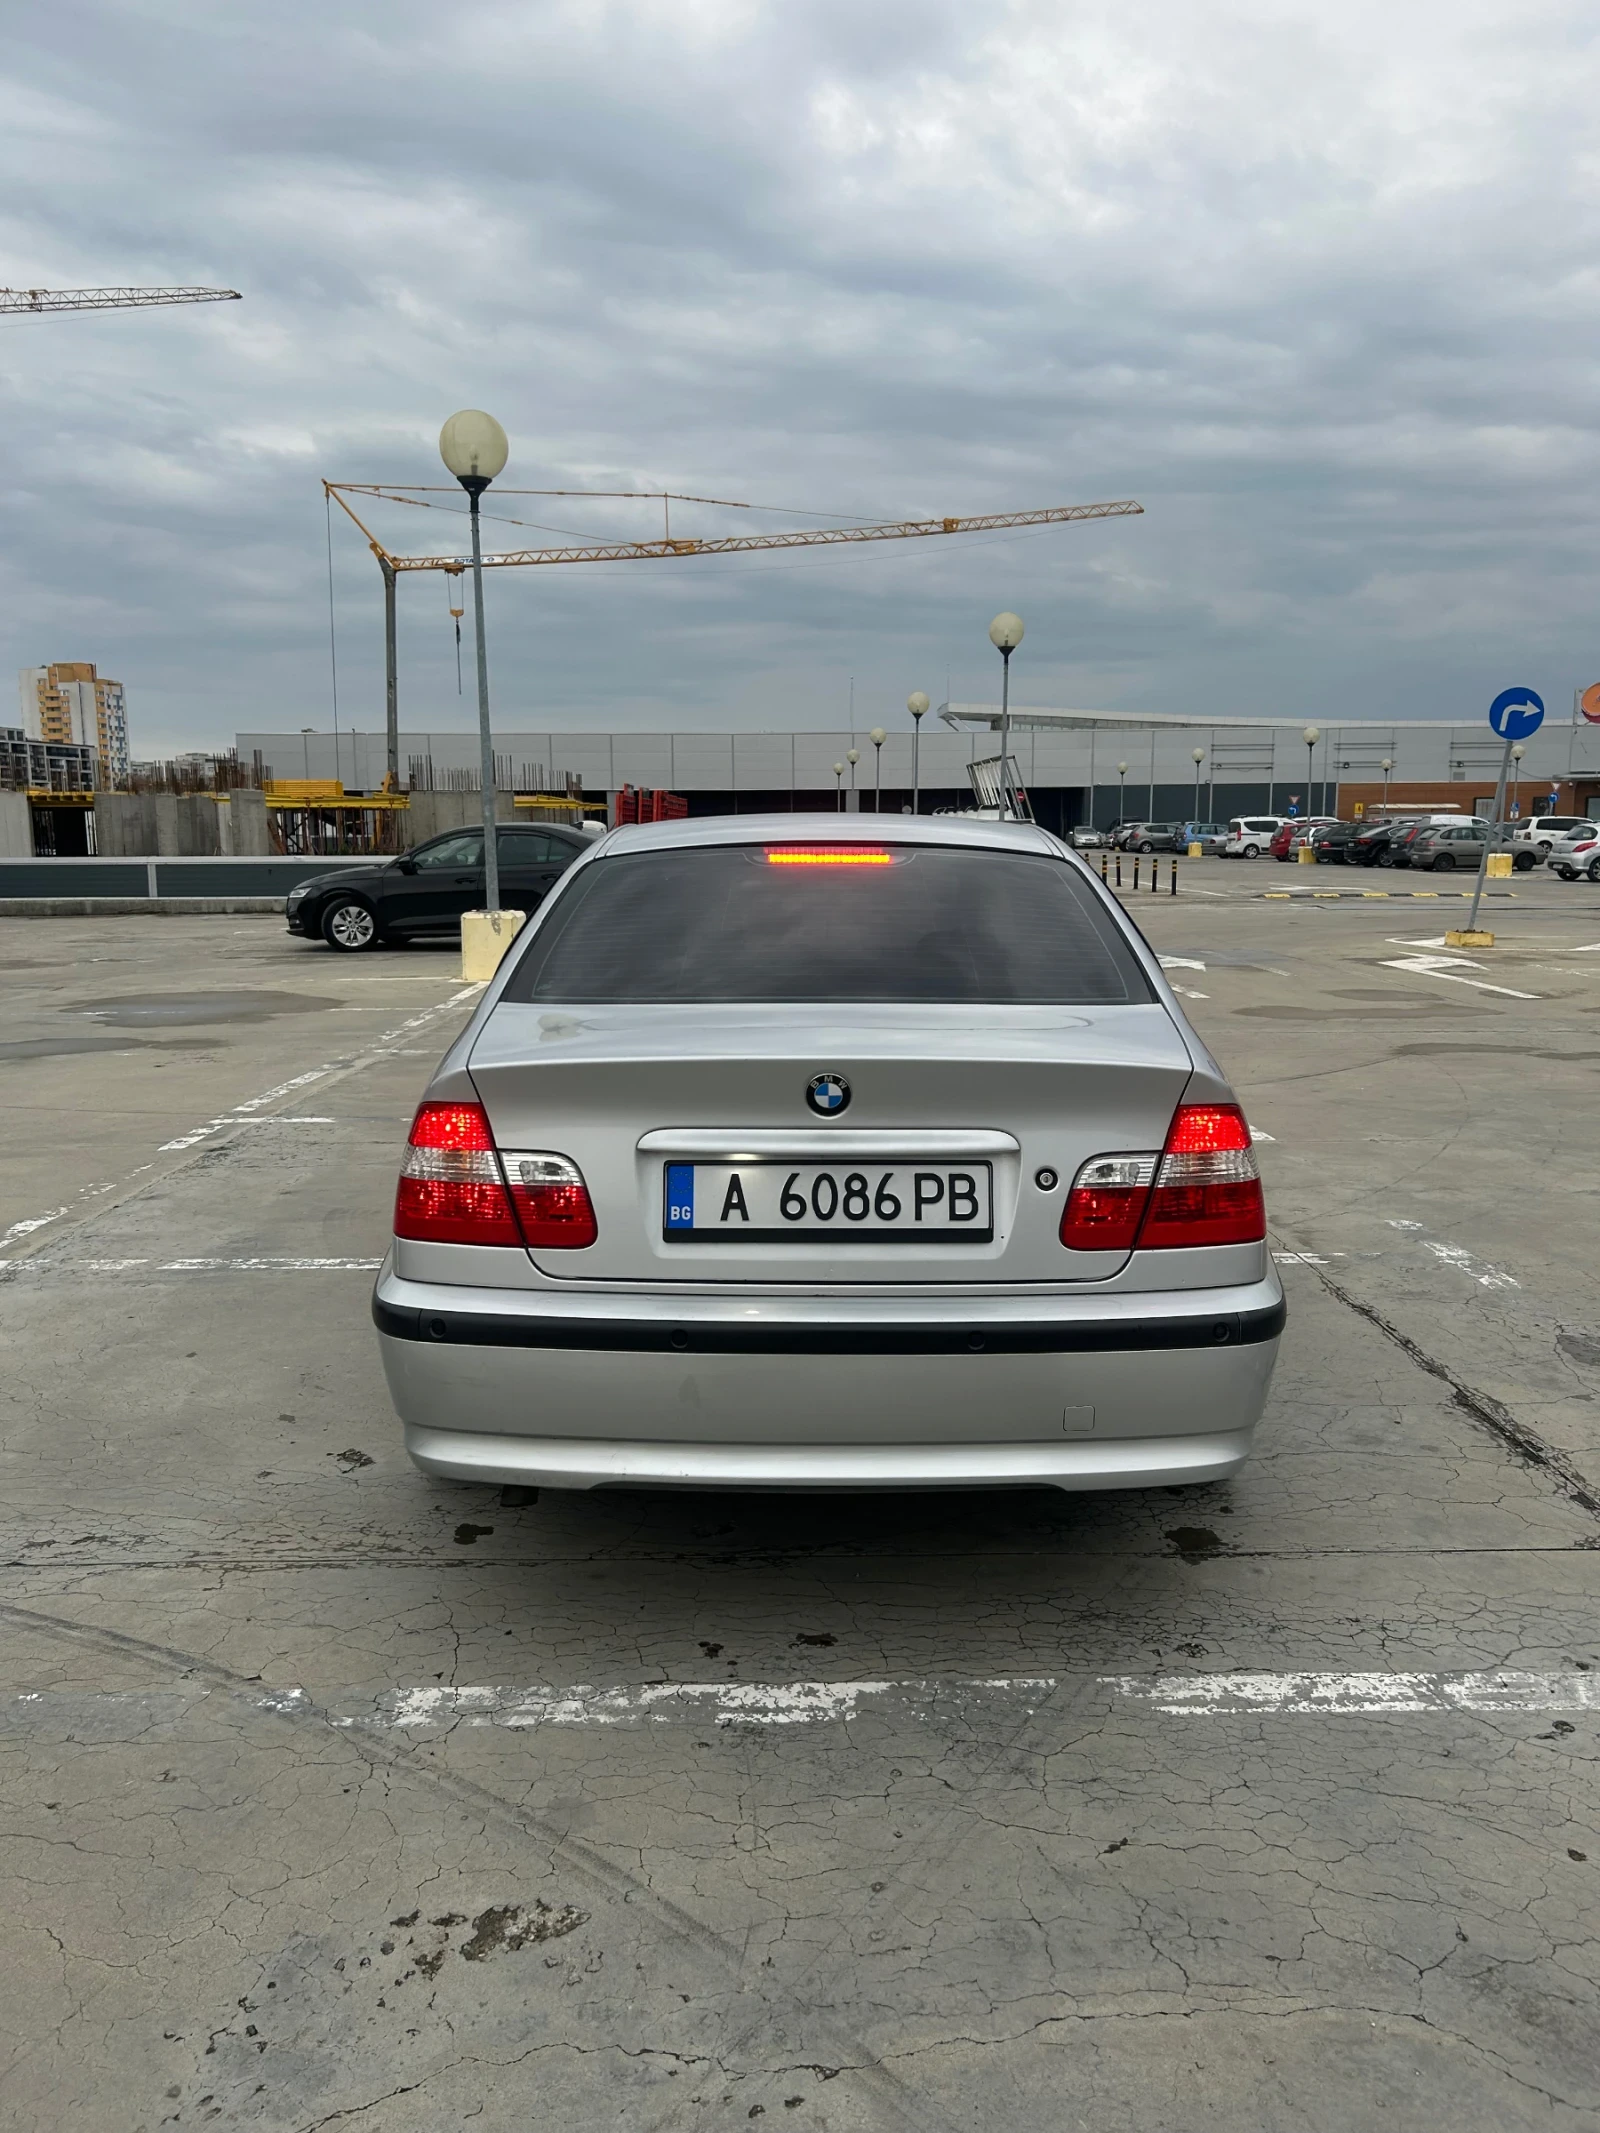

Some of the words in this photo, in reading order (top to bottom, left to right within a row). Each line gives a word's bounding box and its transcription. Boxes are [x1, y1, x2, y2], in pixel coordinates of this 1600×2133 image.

[810, 1075, 848, 1089] BMW
[720, 1173, 750, 1221] A
[780, 1172, 902, 1221] 6086
[914, 1172, 979, 1221] PB
[670, 1206, 691, 1220] BG
